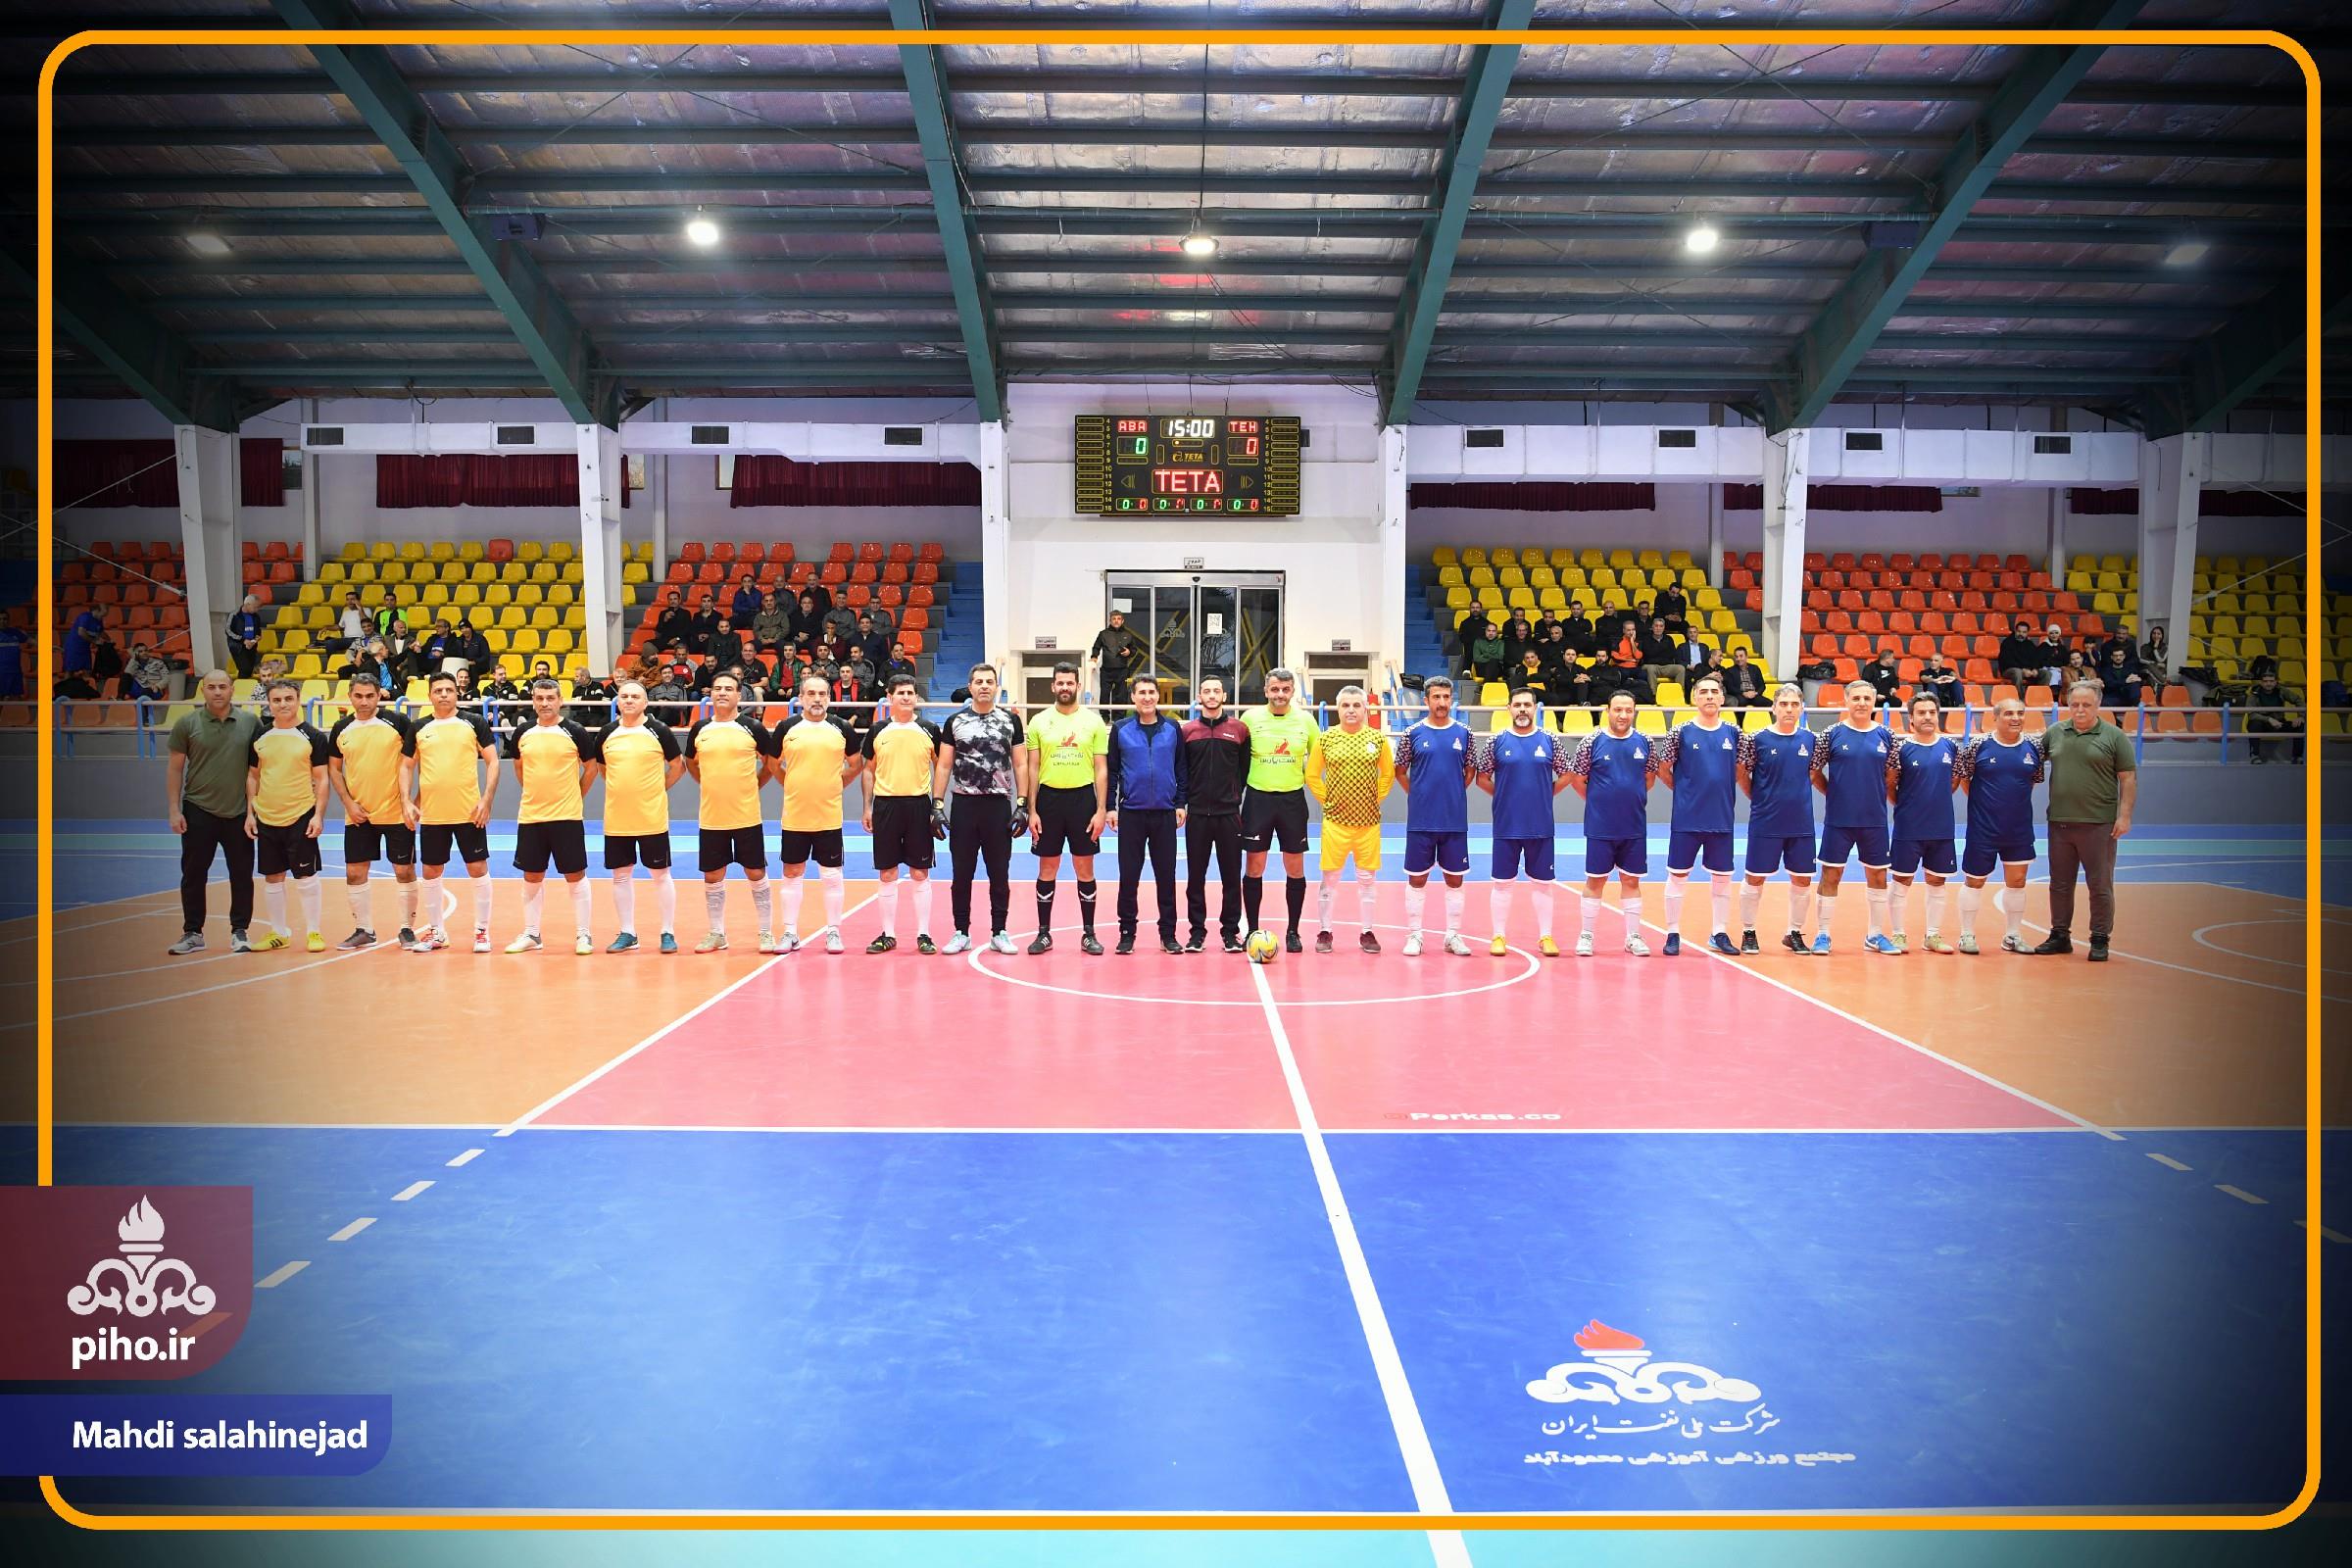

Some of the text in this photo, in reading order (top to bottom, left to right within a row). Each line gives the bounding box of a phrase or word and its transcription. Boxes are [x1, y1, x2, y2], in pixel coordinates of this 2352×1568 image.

[1119, 421, 1146, 431] ABA
[1167, 419, 1214, 437] 15:00
[1230, 421, 1256, 432] TEH
[1136, 437, 1147, 455] 0
[1246, 438, 1257, 455] 0
[1154, 470, 1220, 492] TETA
[1542, 1402, 1781, 1440] شرکت ملی نفت ایران
[1628, 1450, 1709, 1466] آموزشی
[1714, 1450, 1789, 1466] ورزشی
[1794, 1449, 1856, 1466] مجتمع
